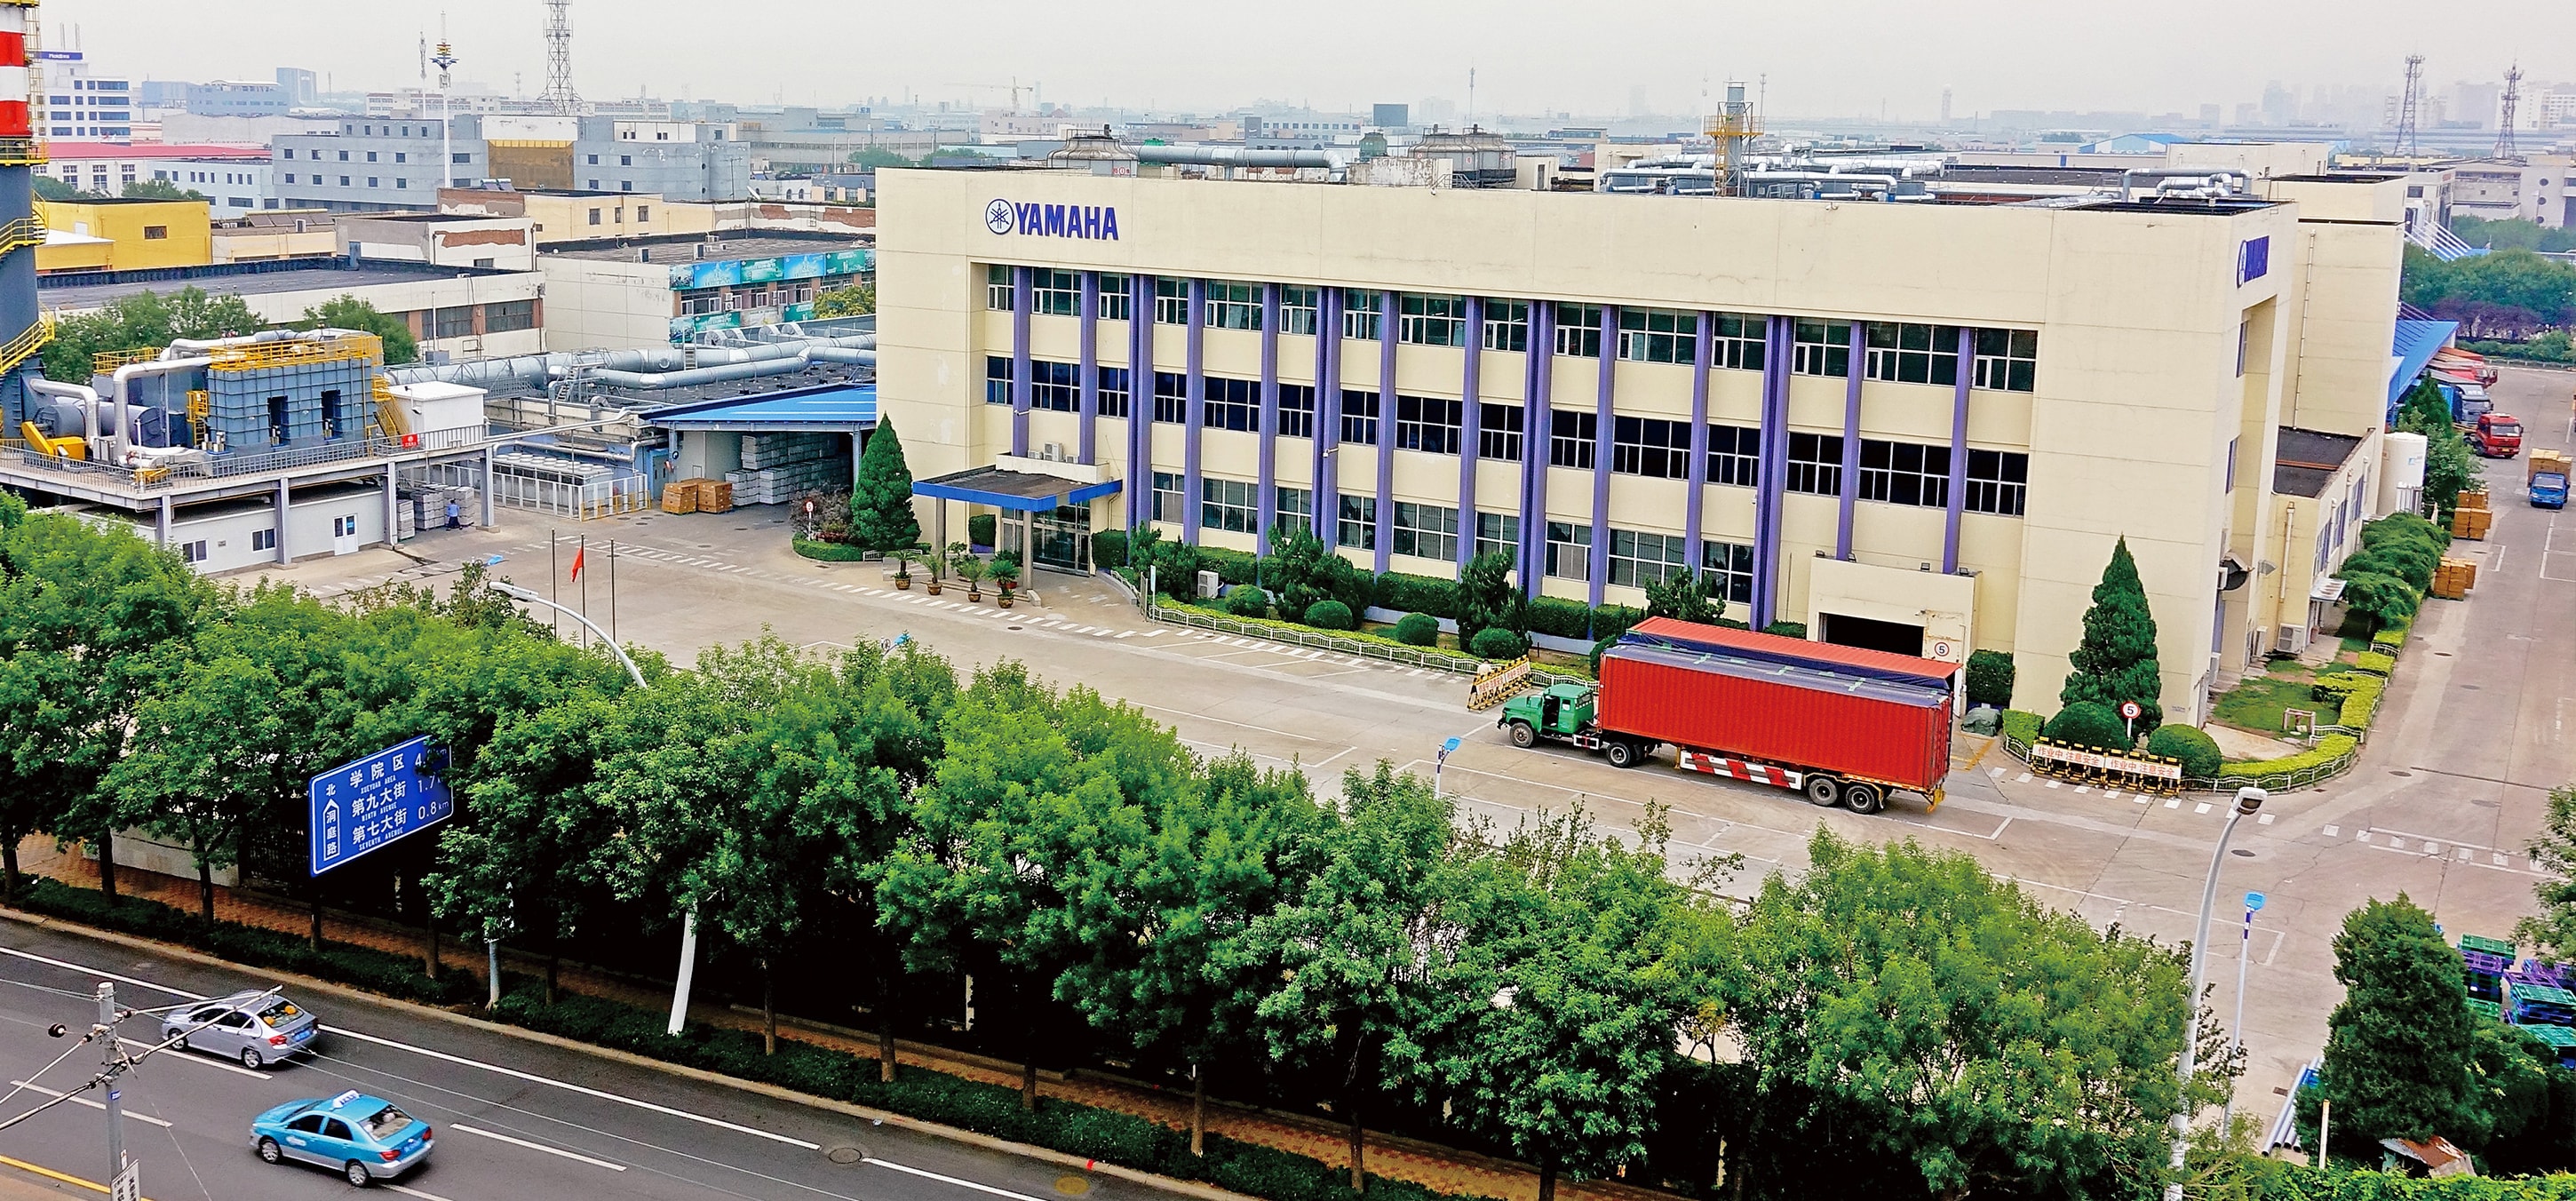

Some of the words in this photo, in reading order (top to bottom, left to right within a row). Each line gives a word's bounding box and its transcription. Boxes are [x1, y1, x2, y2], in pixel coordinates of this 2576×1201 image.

[1015, 203, 1119, 241] YAMAHA
[1938, 645, 1945, 654] 5
[2127, 705, 2135, 715] 5
[2038, 746, 2063, 759] 作业中
[2065, 751, 2100, 767] 注意安全
[350, 753, 404, 788] 学院区
[2111, 759, 2136, 771] 作业中
[2139, 763, 2174, 776] 注意安全
[326, 783, 336, 796] 北
[352, 781, 406, 817] 第九大街
[353, 807, 407, 845] 第七大街
